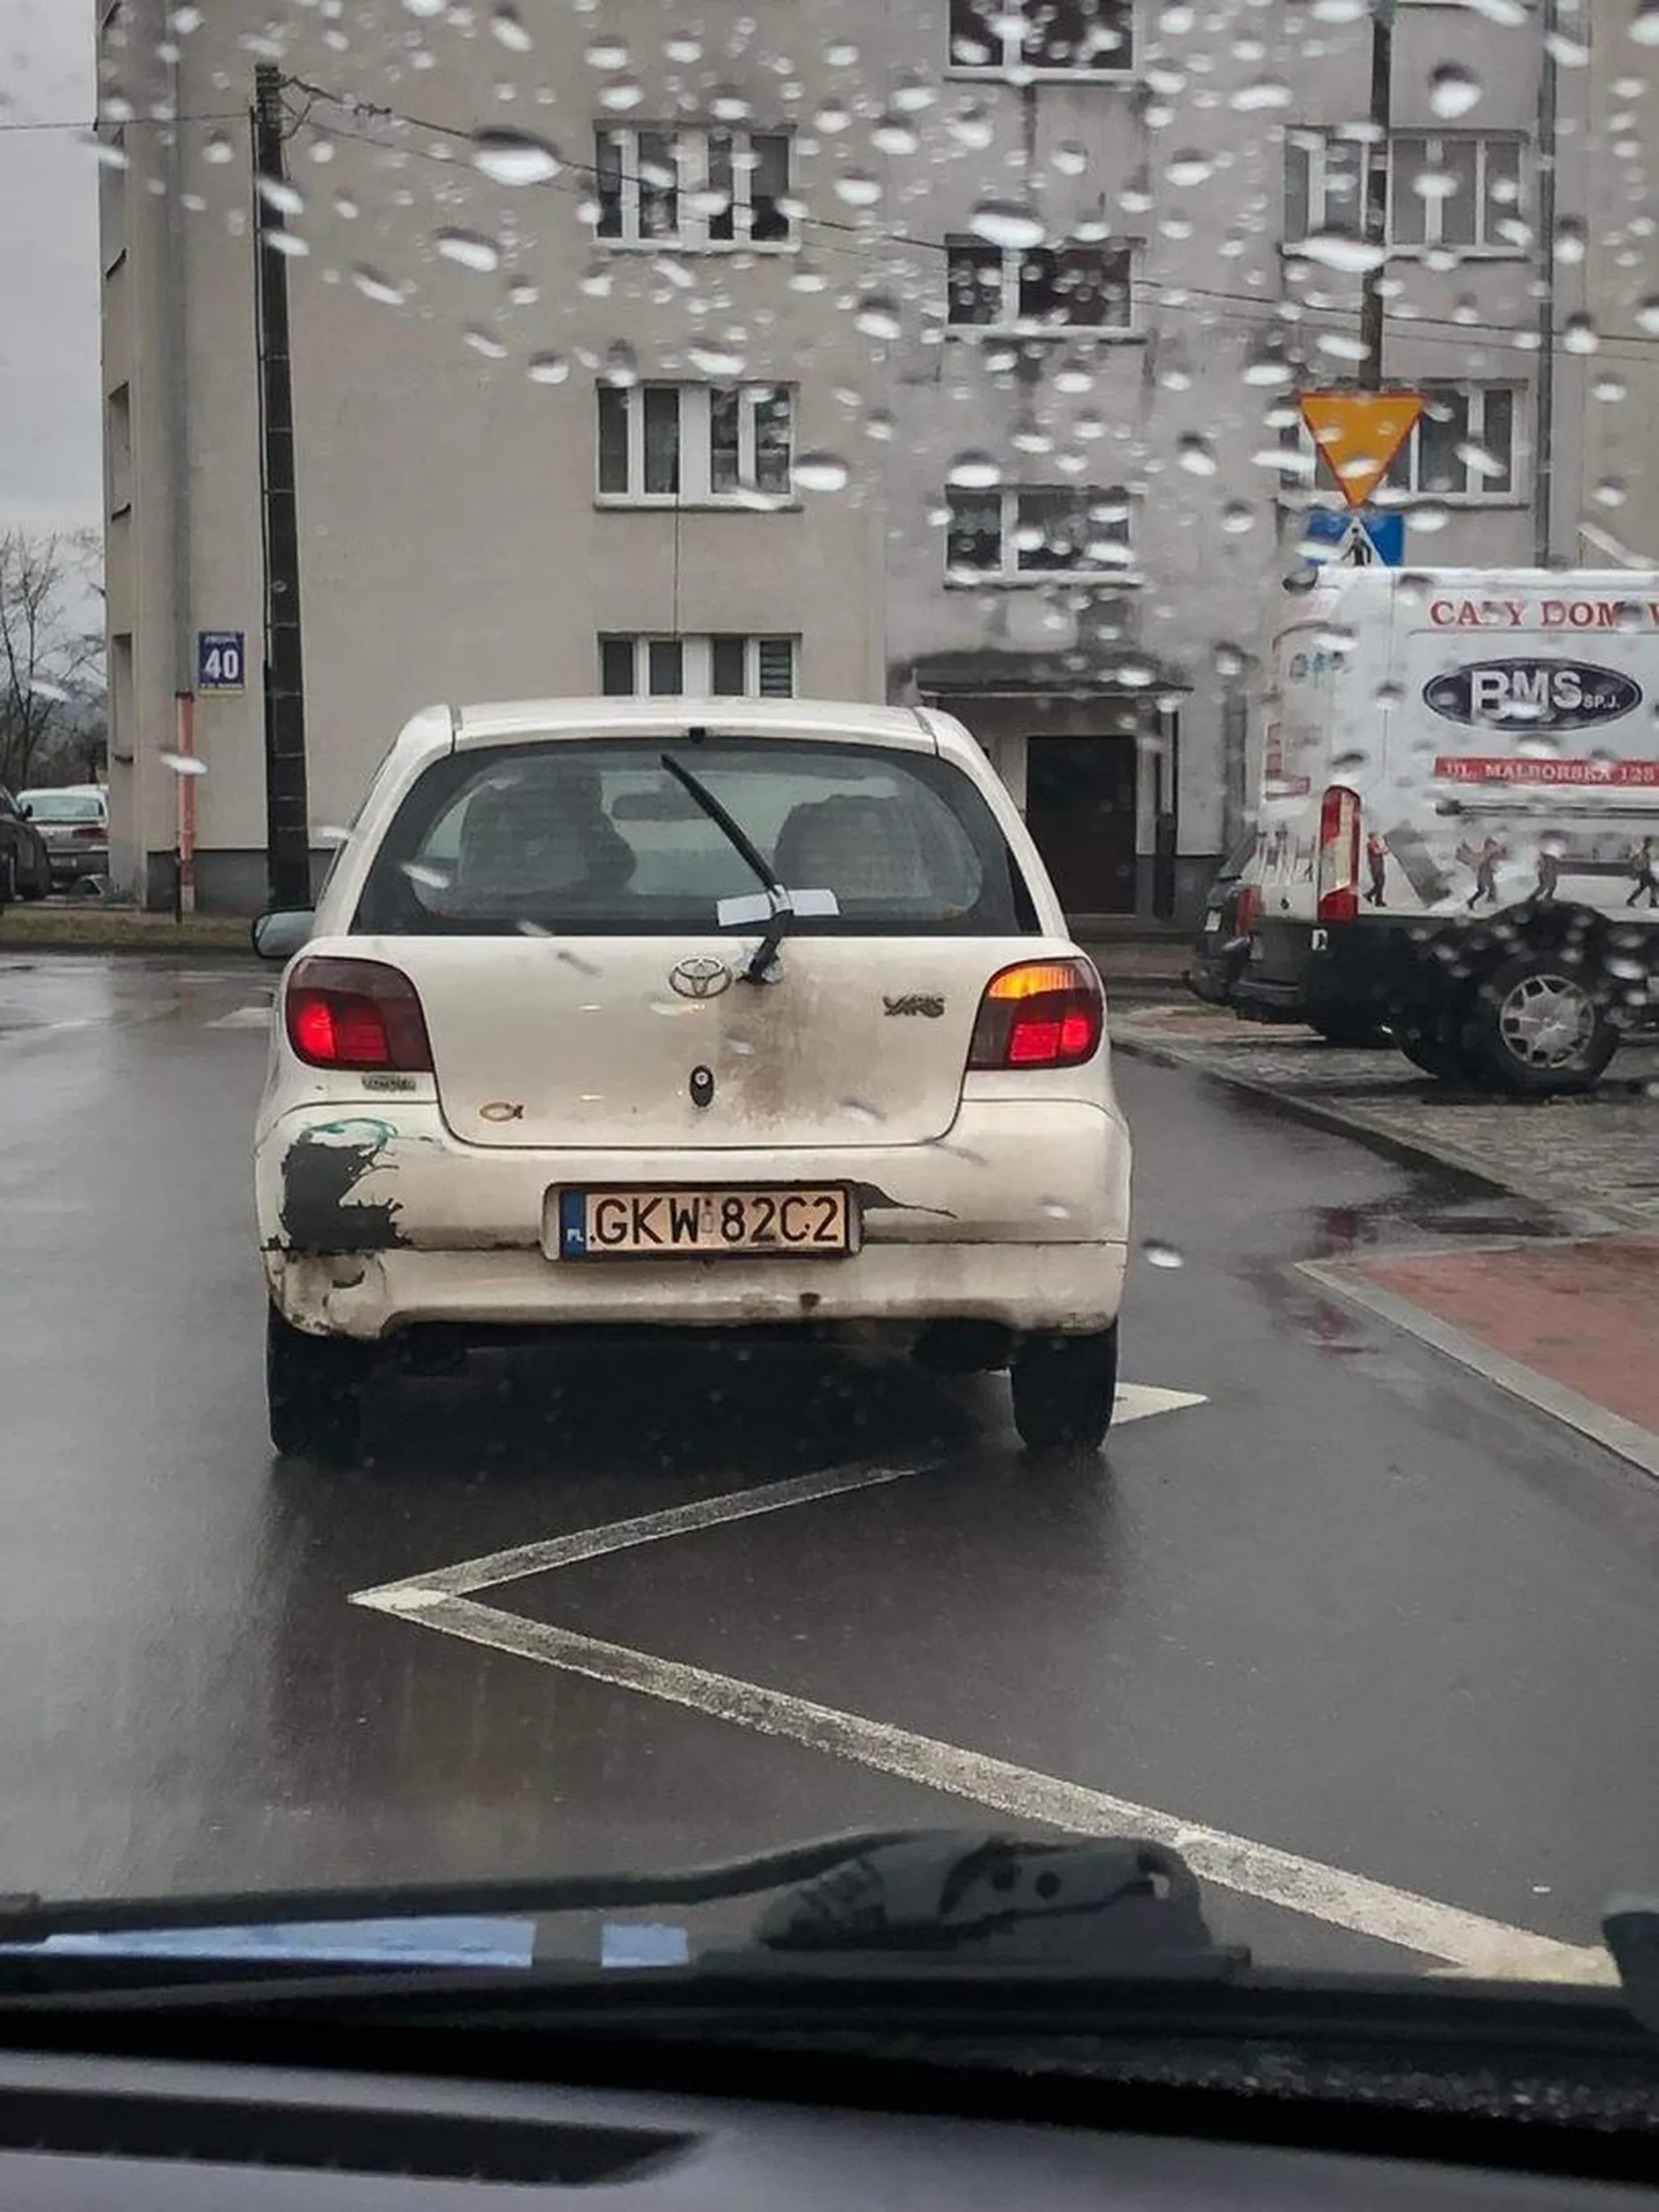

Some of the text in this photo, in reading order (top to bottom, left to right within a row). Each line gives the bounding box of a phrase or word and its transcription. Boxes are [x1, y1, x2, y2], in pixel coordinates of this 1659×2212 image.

[1430, 601, 1525, 626] CAY
[205, 648, 239, 680] 40
[595, 1195, 838, 1244] GKW 82C2
[567, 1228, 584, 1241] PL
